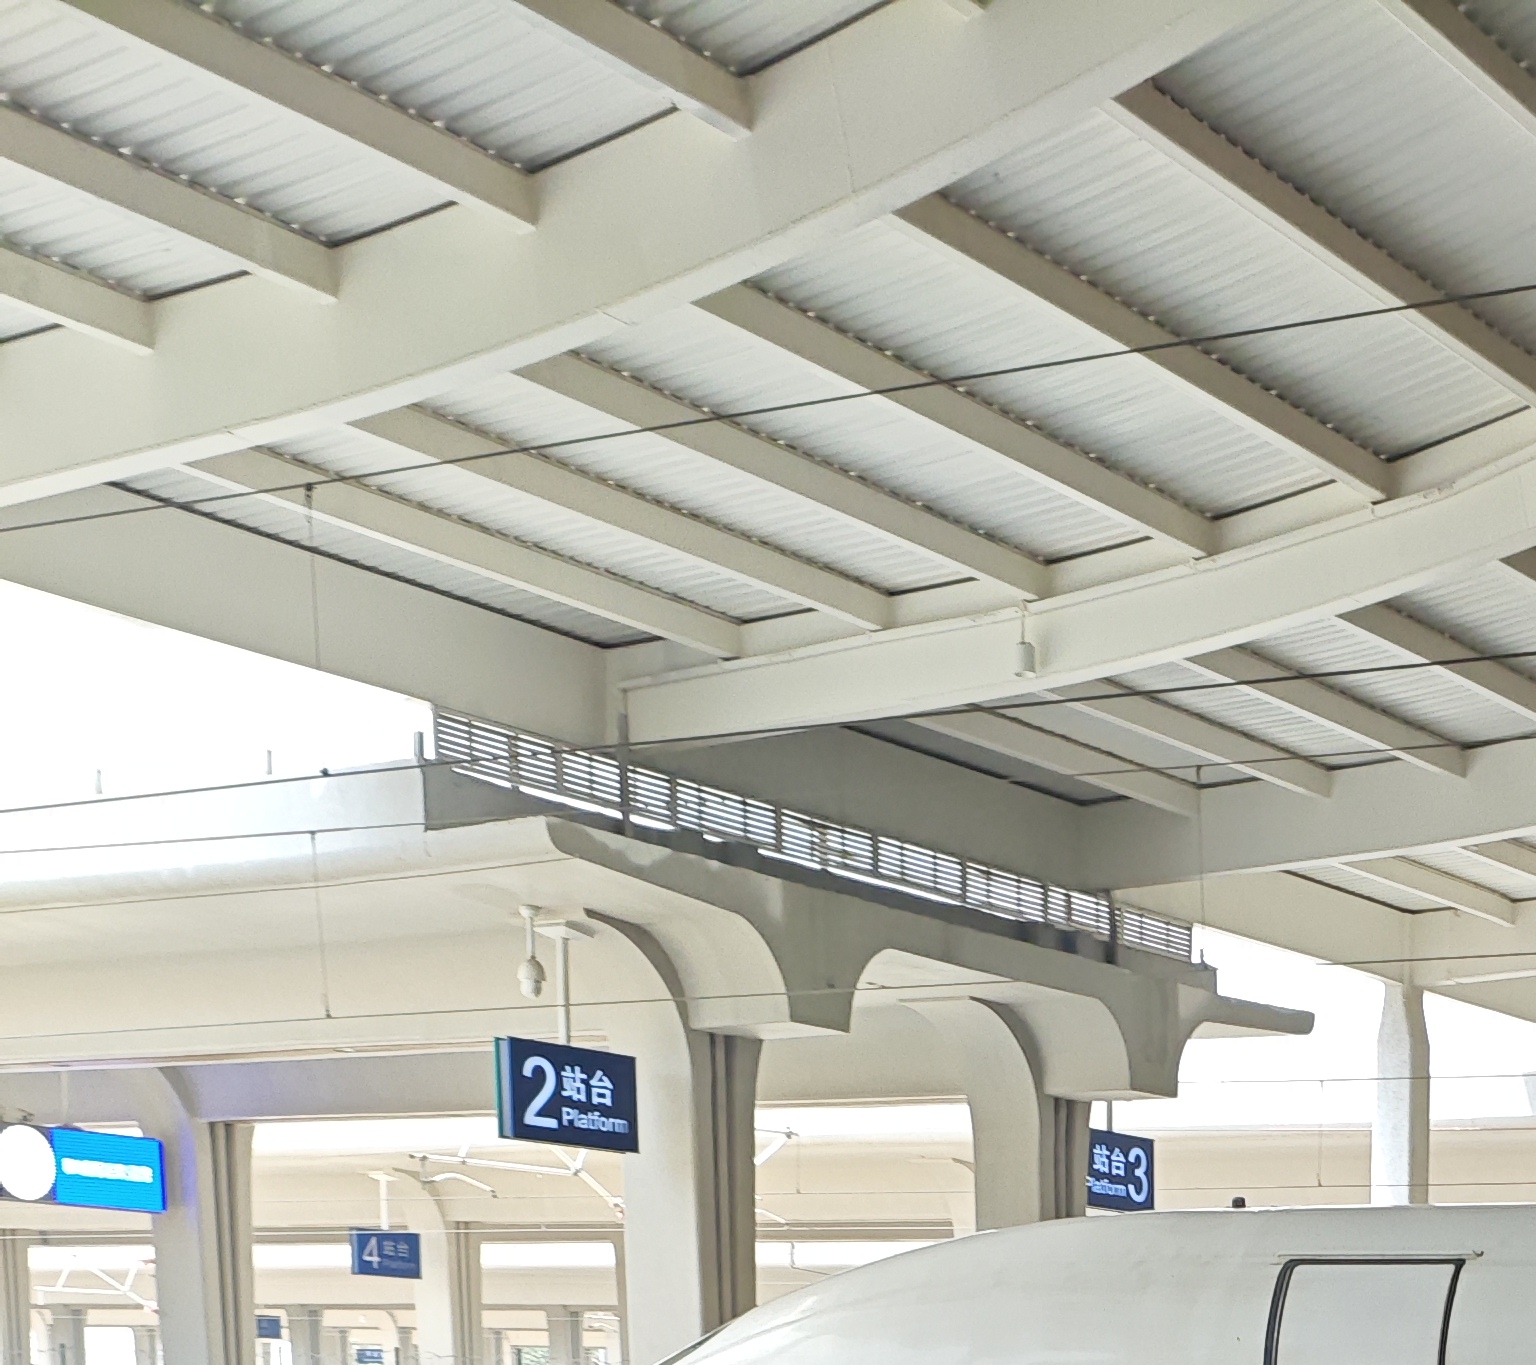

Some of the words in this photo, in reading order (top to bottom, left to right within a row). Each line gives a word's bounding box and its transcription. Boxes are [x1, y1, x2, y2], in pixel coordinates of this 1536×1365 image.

[522, 1055, 559, 1129] 2
[560, 1064, 614, 1108] 站台
[561, 1105, 630, 1134] Platform
[1092, 1143, 1127, 1177] 站台
[1127, 1146, 1149, 1203] 3
[361, 1235, 382, 1270] 4
